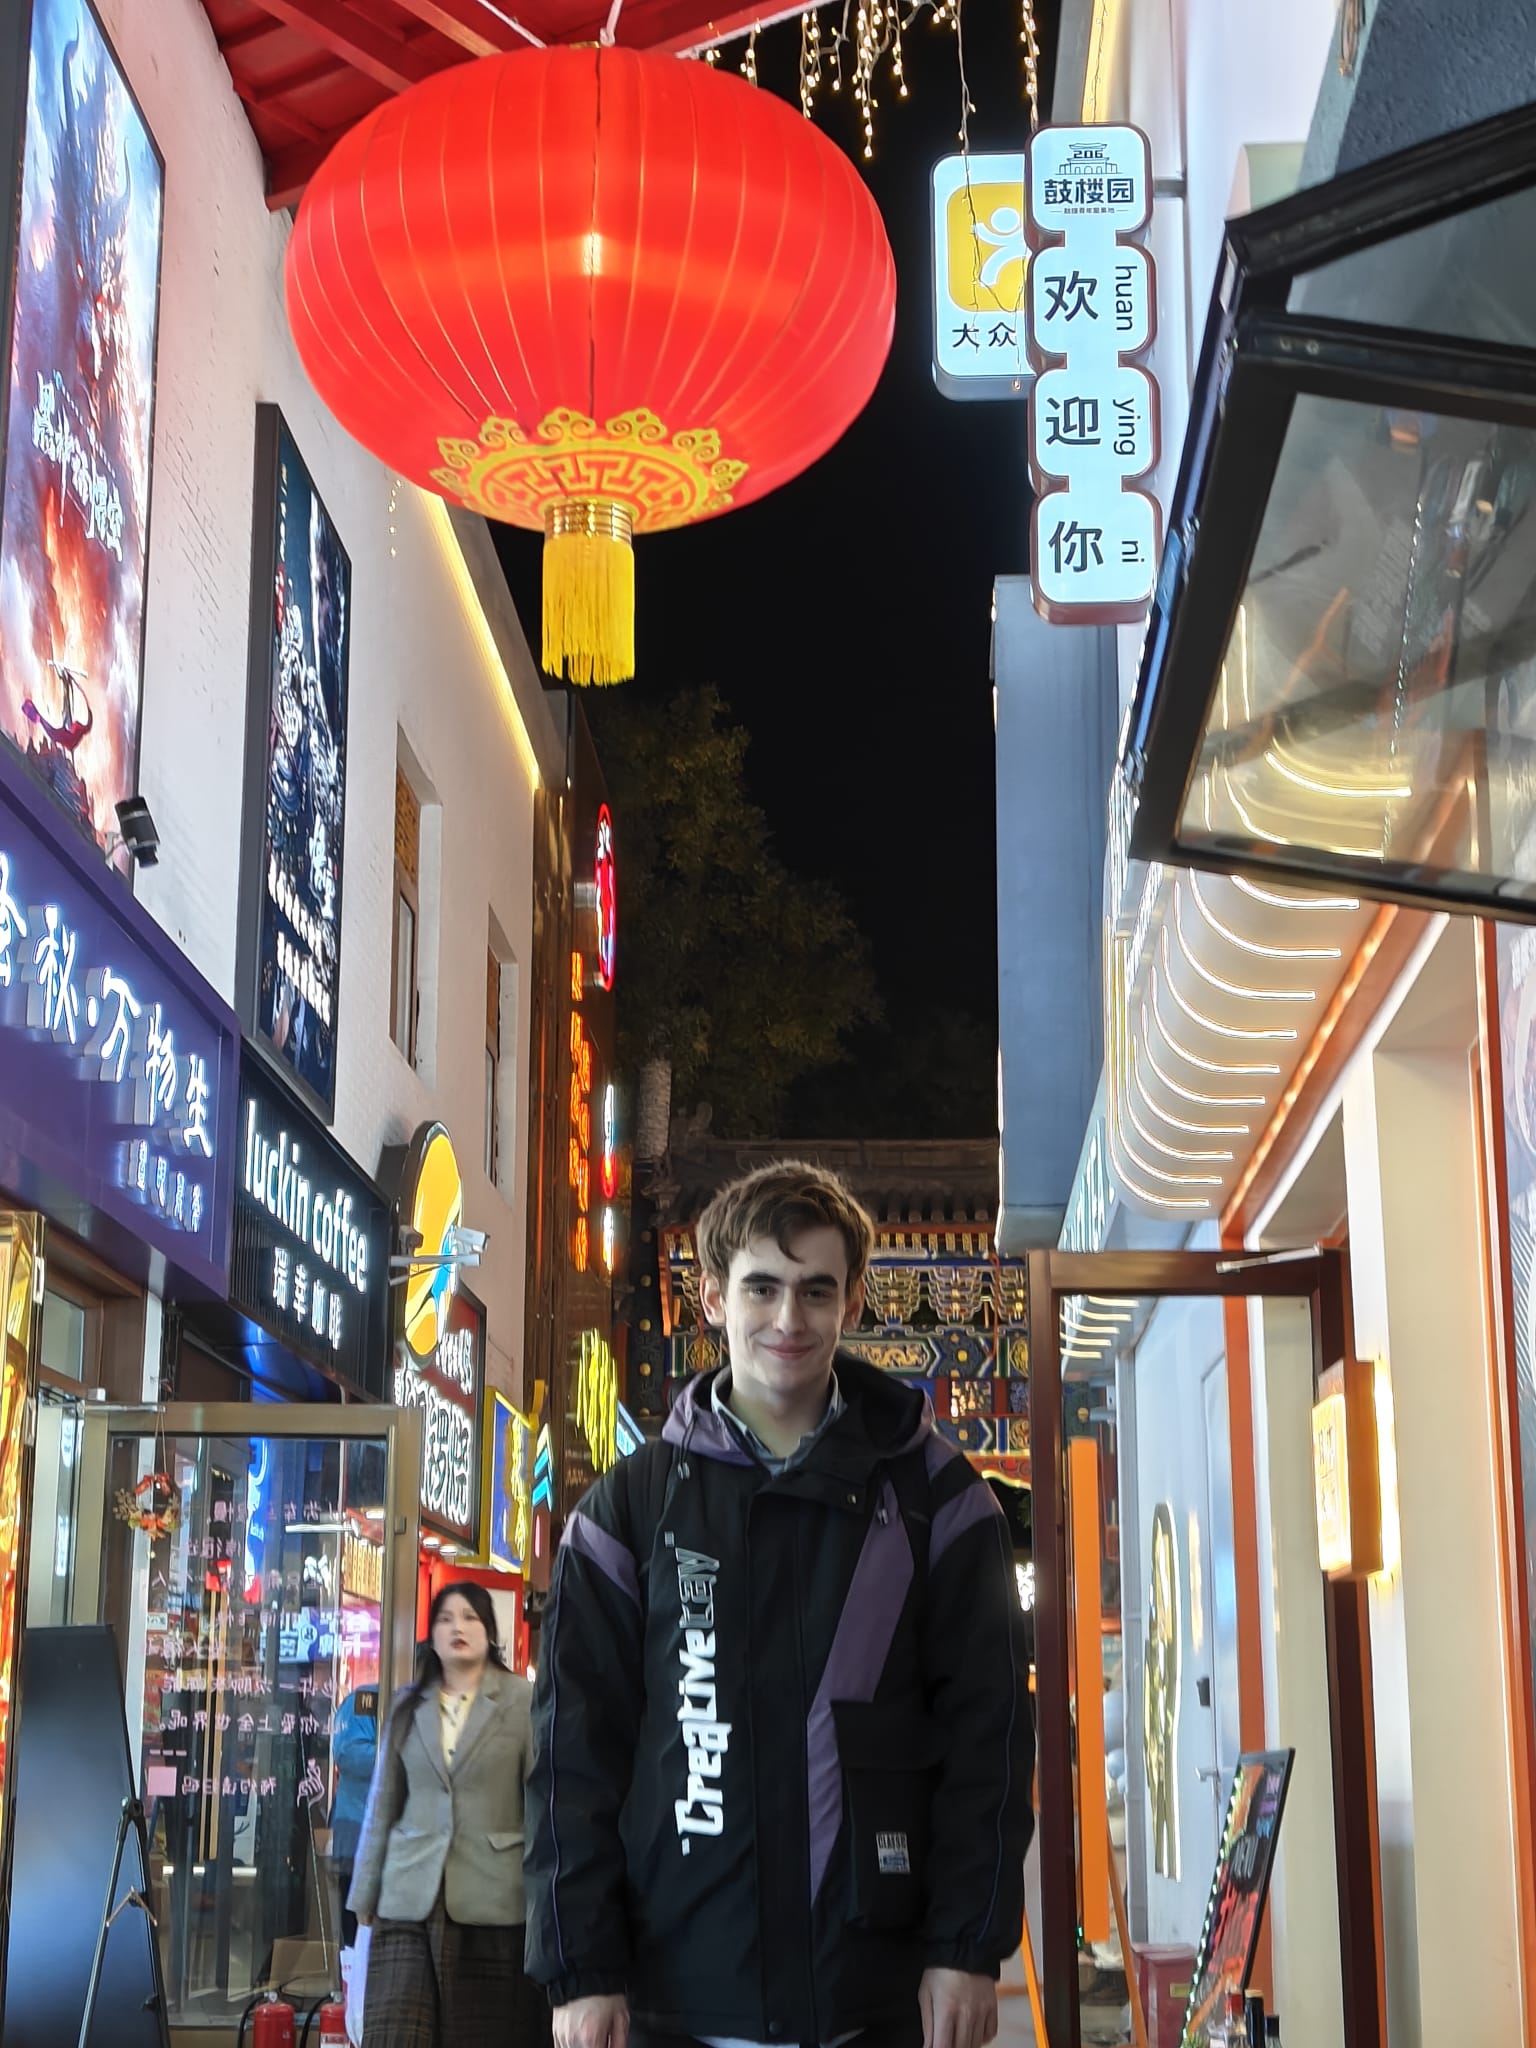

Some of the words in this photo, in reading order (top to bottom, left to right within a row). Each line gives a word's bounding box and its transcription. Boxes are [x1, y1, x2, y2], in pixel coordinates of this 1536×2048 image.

[1073, 149, 1104, 159] 206
[1043, 177, 1135, 205] 鼓楼园
[1114, 263, 1138, 332] huan
[951, 321, 1018, 349] 大众
[1112, 397, 1137, 457] ying
[1120, 539, 1145, 564] ni
[244, 1098, 311, 1244] luckin
[312, 1187, 369, 1294] coffee
[272, 1245, 344, 1352] 瑞幸咖啡
